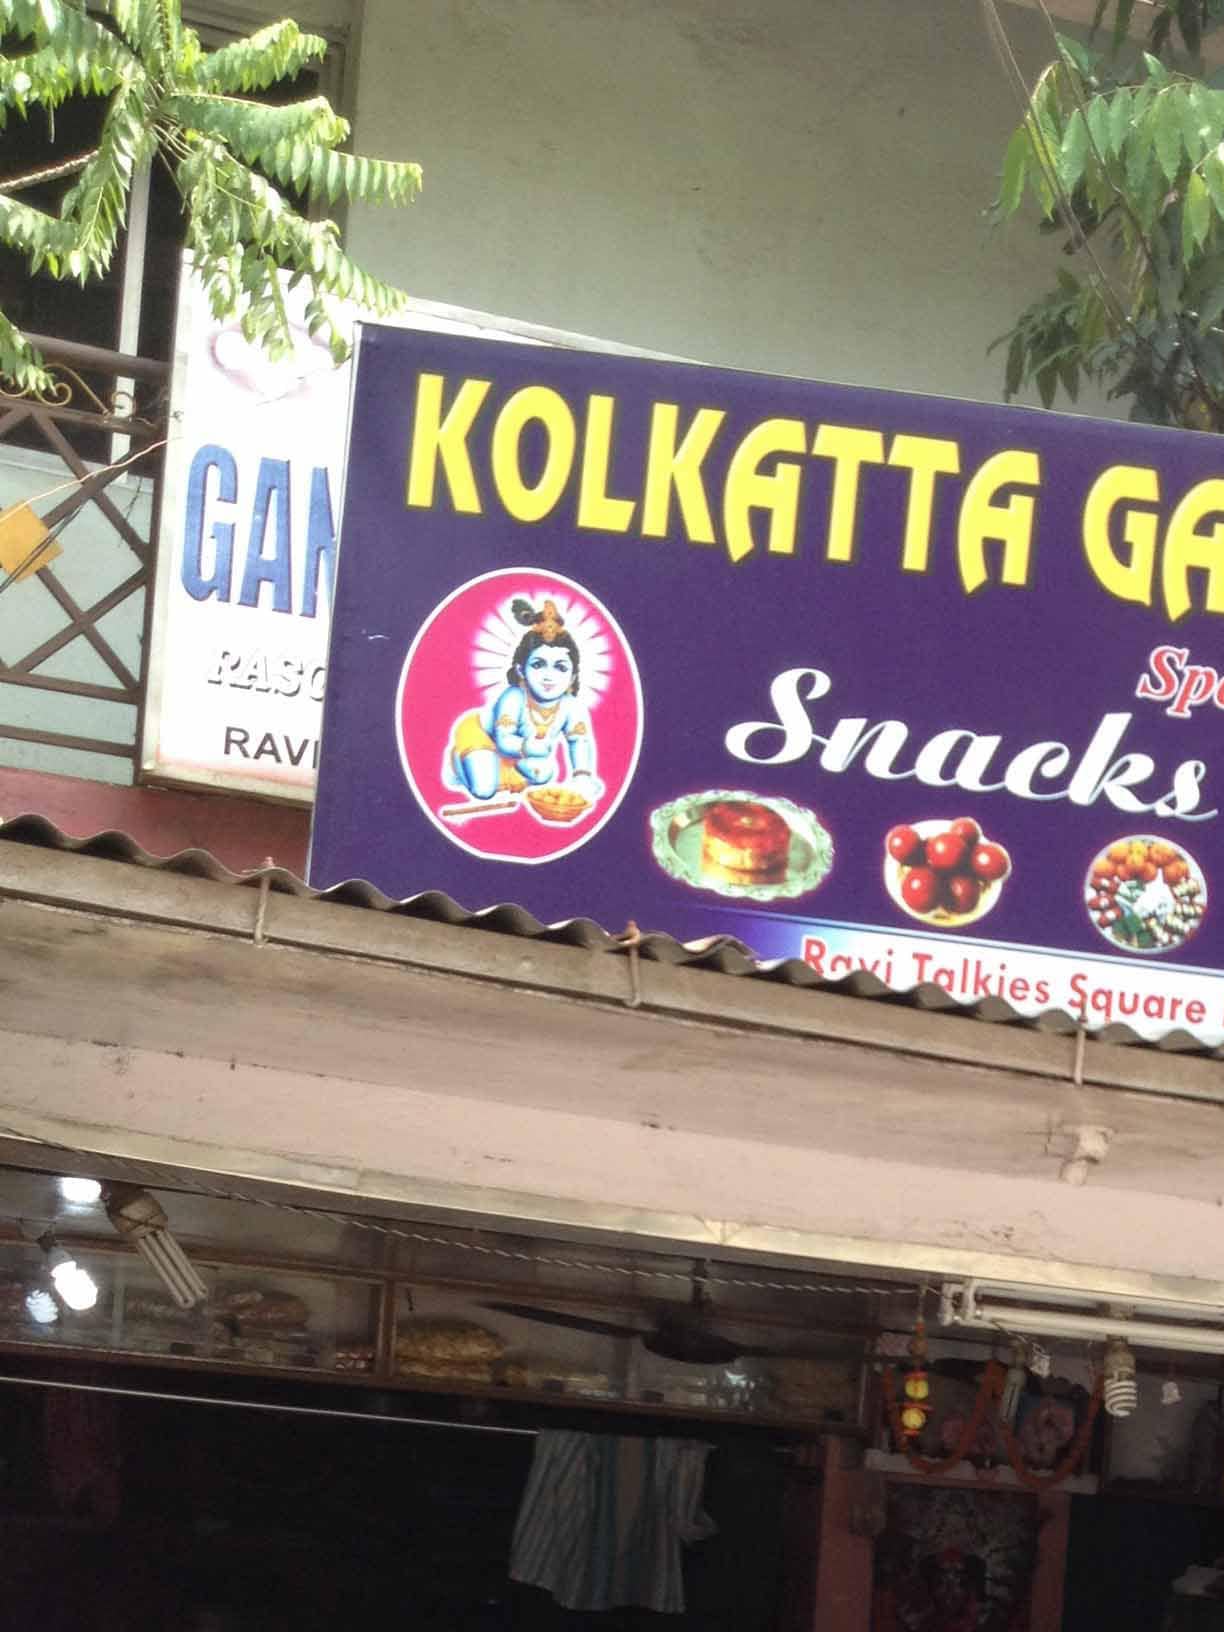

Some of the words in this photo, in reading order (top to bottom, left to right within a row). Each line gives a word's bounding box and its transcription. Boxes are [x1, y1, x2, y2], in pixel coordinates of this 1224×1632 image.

[406, 373, 1042, 594] KOLKATTA
[724, 666, 1219, 822] Snacks
[912, 951, 1050, 1004] Talkies
[1069, 972, 1207, 1026] Square
